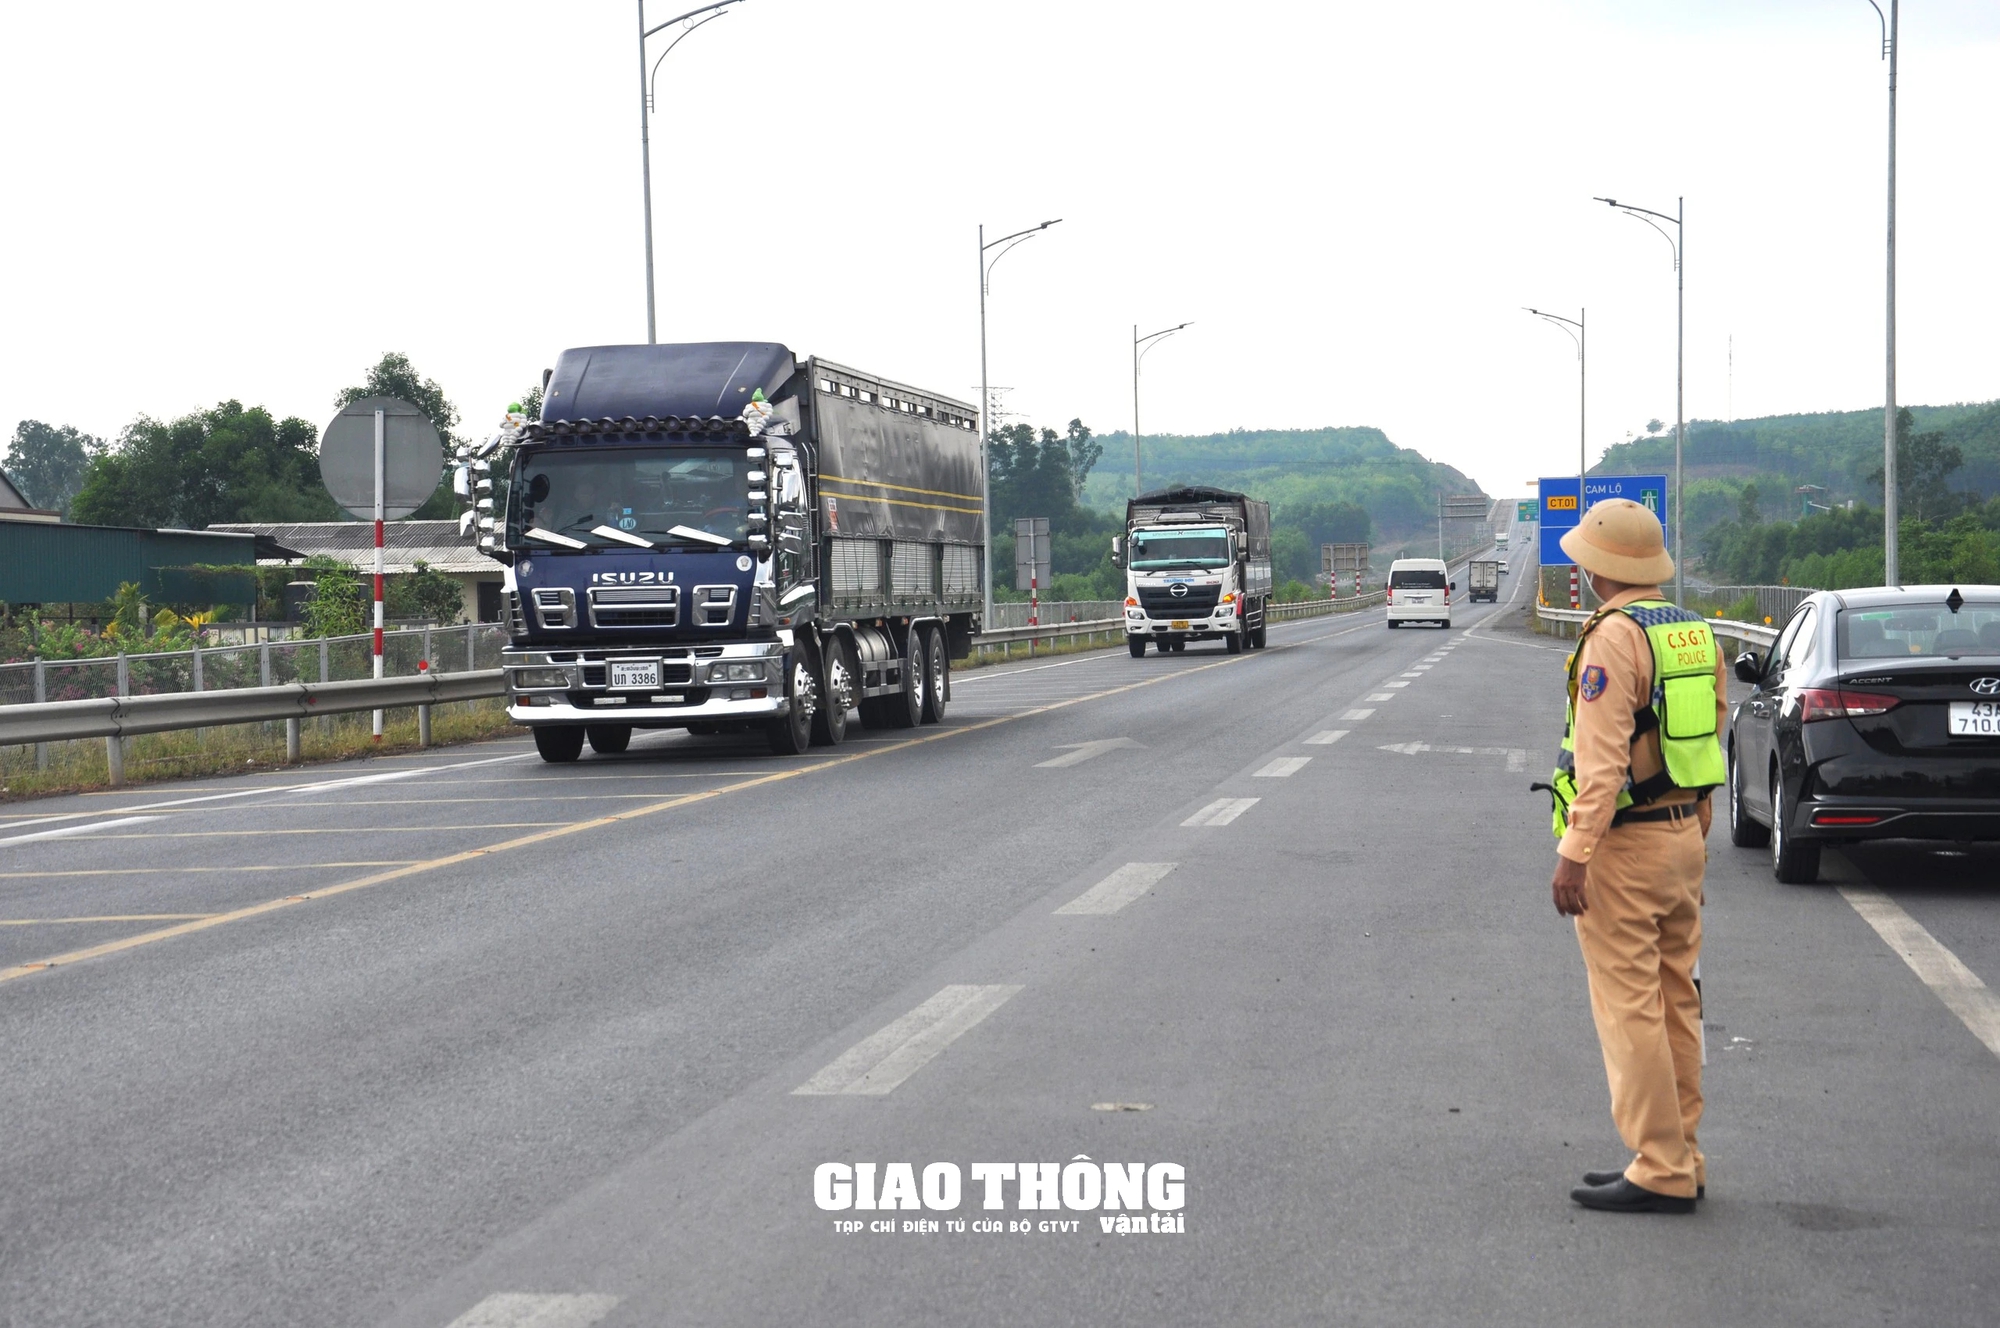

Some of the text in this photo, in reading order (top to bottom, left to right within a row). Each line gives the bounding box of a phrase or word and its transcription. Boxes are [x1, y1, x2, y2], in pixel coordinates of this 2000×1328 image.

[1585, 482, 1622, 496] CAM LỘ
[1550, 498, 1575, 508] CT.01
[592, 571, 674, 585] ISUZU
[1667, 629, 1707, 649] C.S.G.T
[1677, 650, 1708, 666] POLICE
[631, 672, 656, 685] 3386
[1849, 677, 1893, 685] ACCENT
